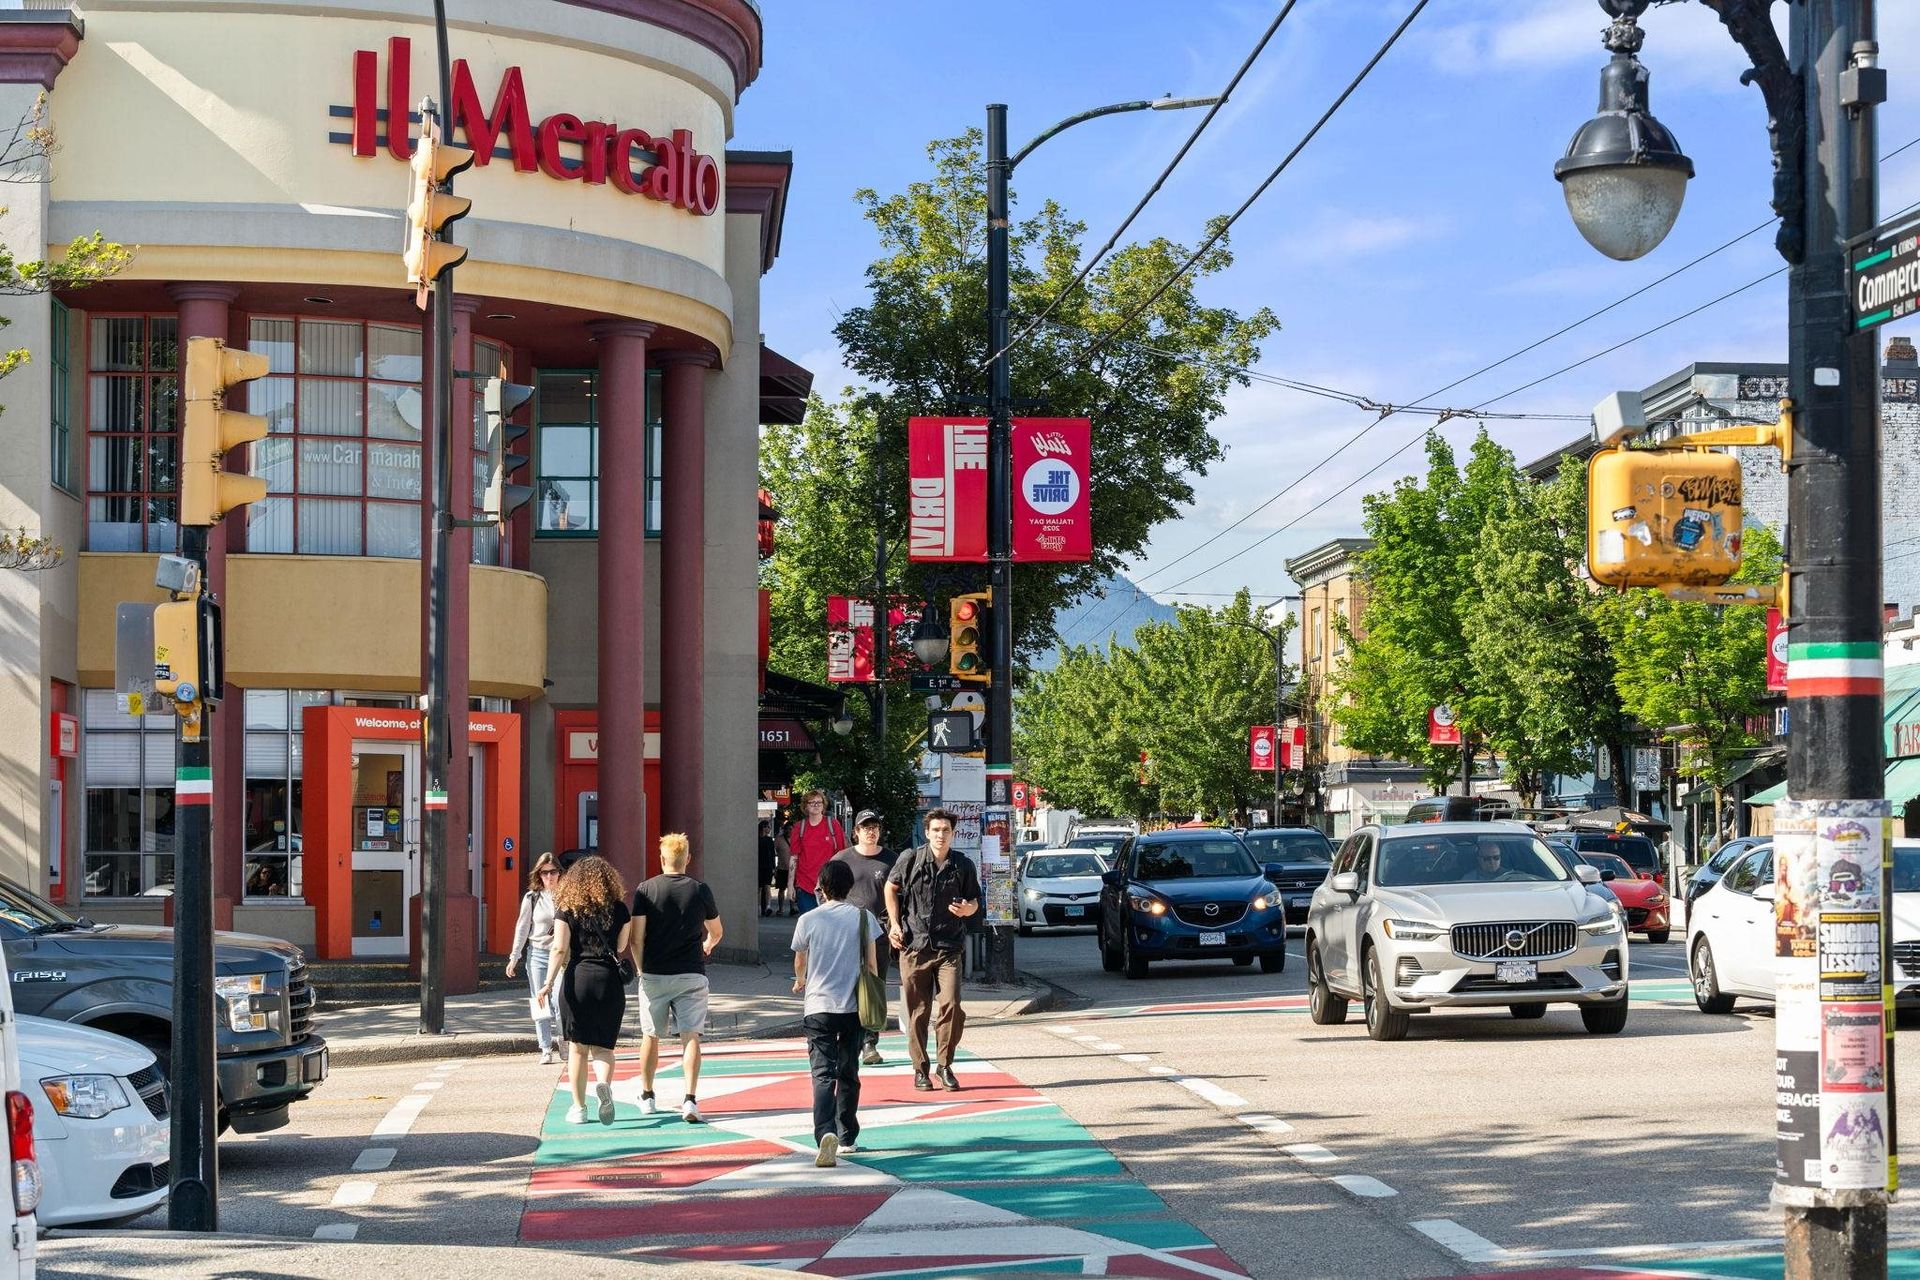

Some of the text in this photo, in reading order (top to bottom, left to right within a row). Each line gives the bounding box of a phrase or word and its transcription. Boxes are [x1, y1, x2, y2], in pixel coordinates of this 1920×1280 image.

[353, 36, 720, 217] Il Mercato
[929, 679, 936, 688] E.
[355, 717, 409, 731] Welcome,
[468, 721, 497, 732] kers.
[760, 730, 790, 742] 1651
[1820, 953, 1879, 973] LESSONS
[1776, 1091, 1819, 1107] VERAGE
